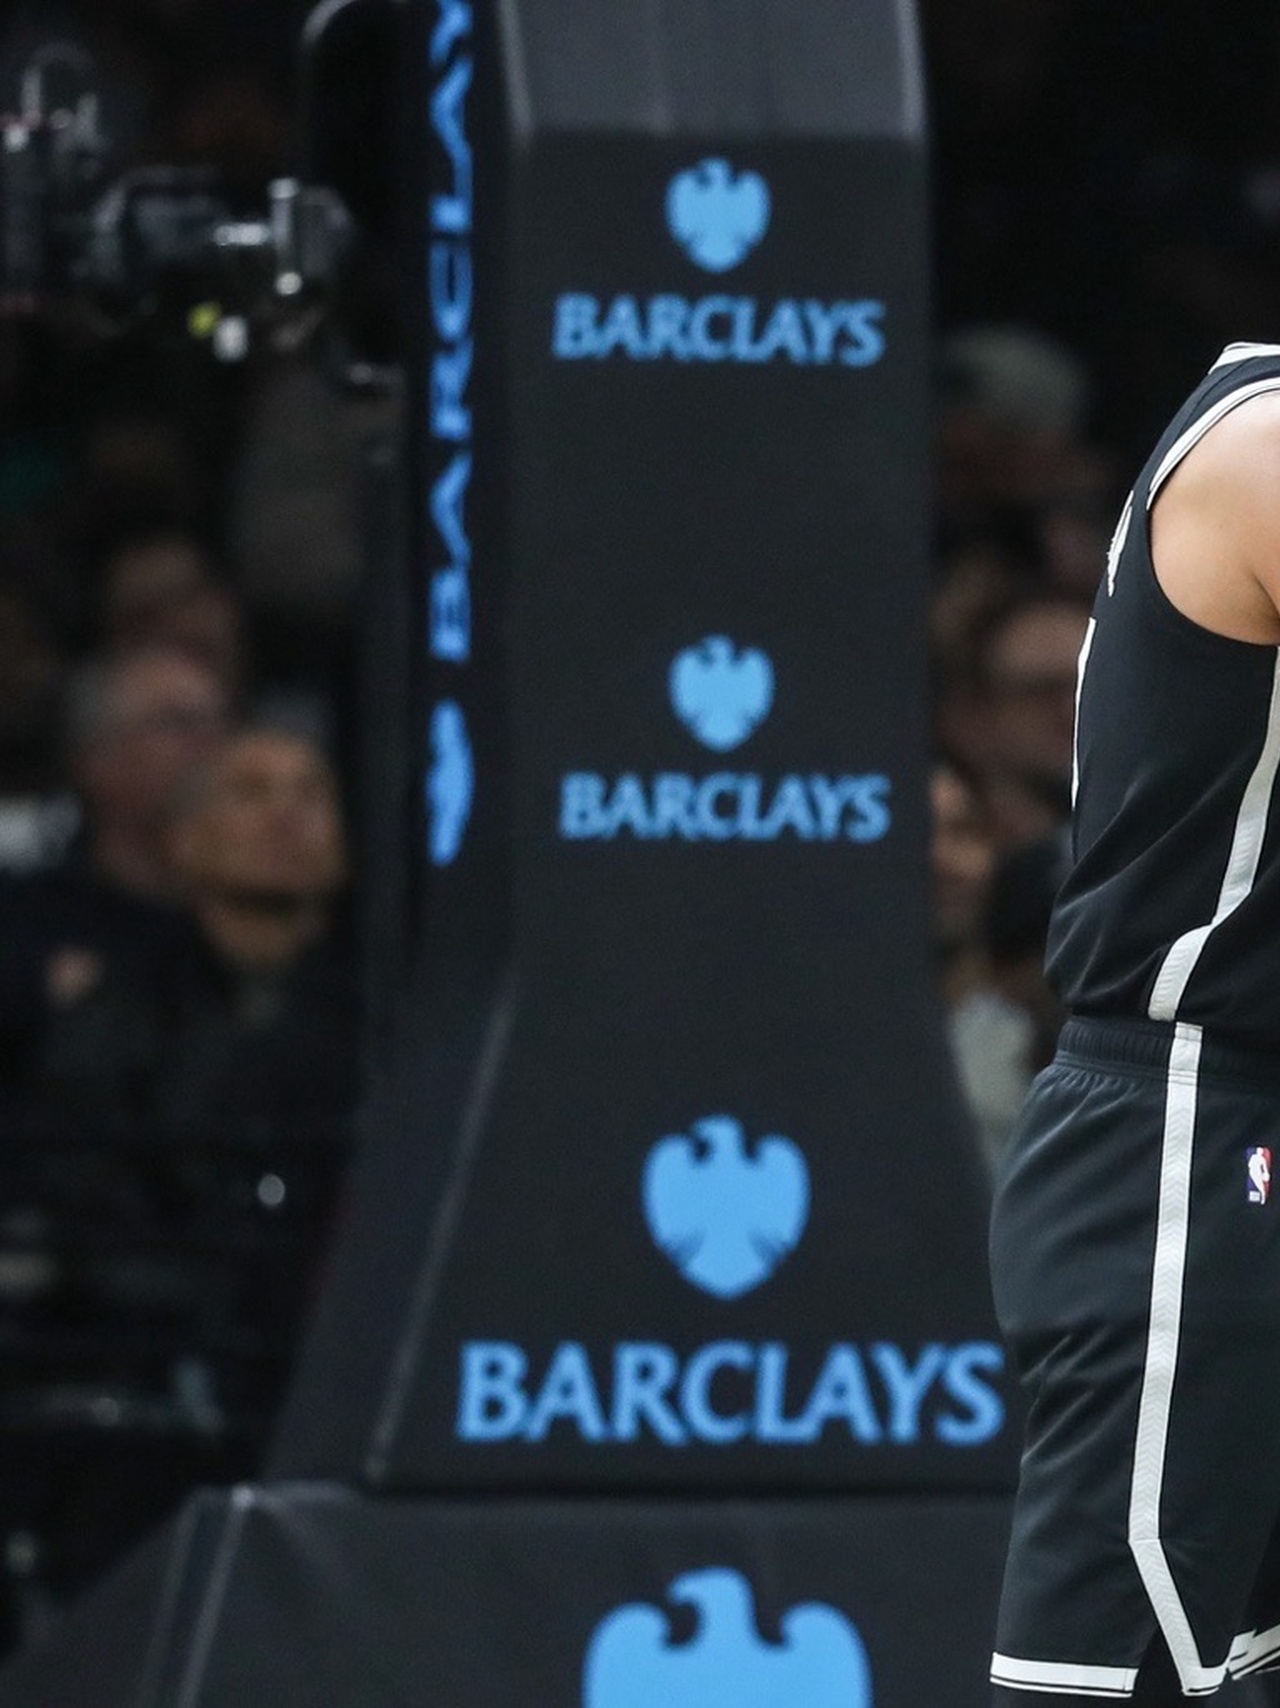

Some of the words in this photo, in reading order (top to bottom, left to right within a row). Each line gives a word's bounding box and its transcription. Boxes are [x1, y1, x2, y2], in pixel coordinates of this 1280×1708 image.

[553, 294, 884, 366] BARCLAYS
[559, 772, 890, 841] BARCLAYS
[457, 1341, 1004, 1445] BARCLAYS
